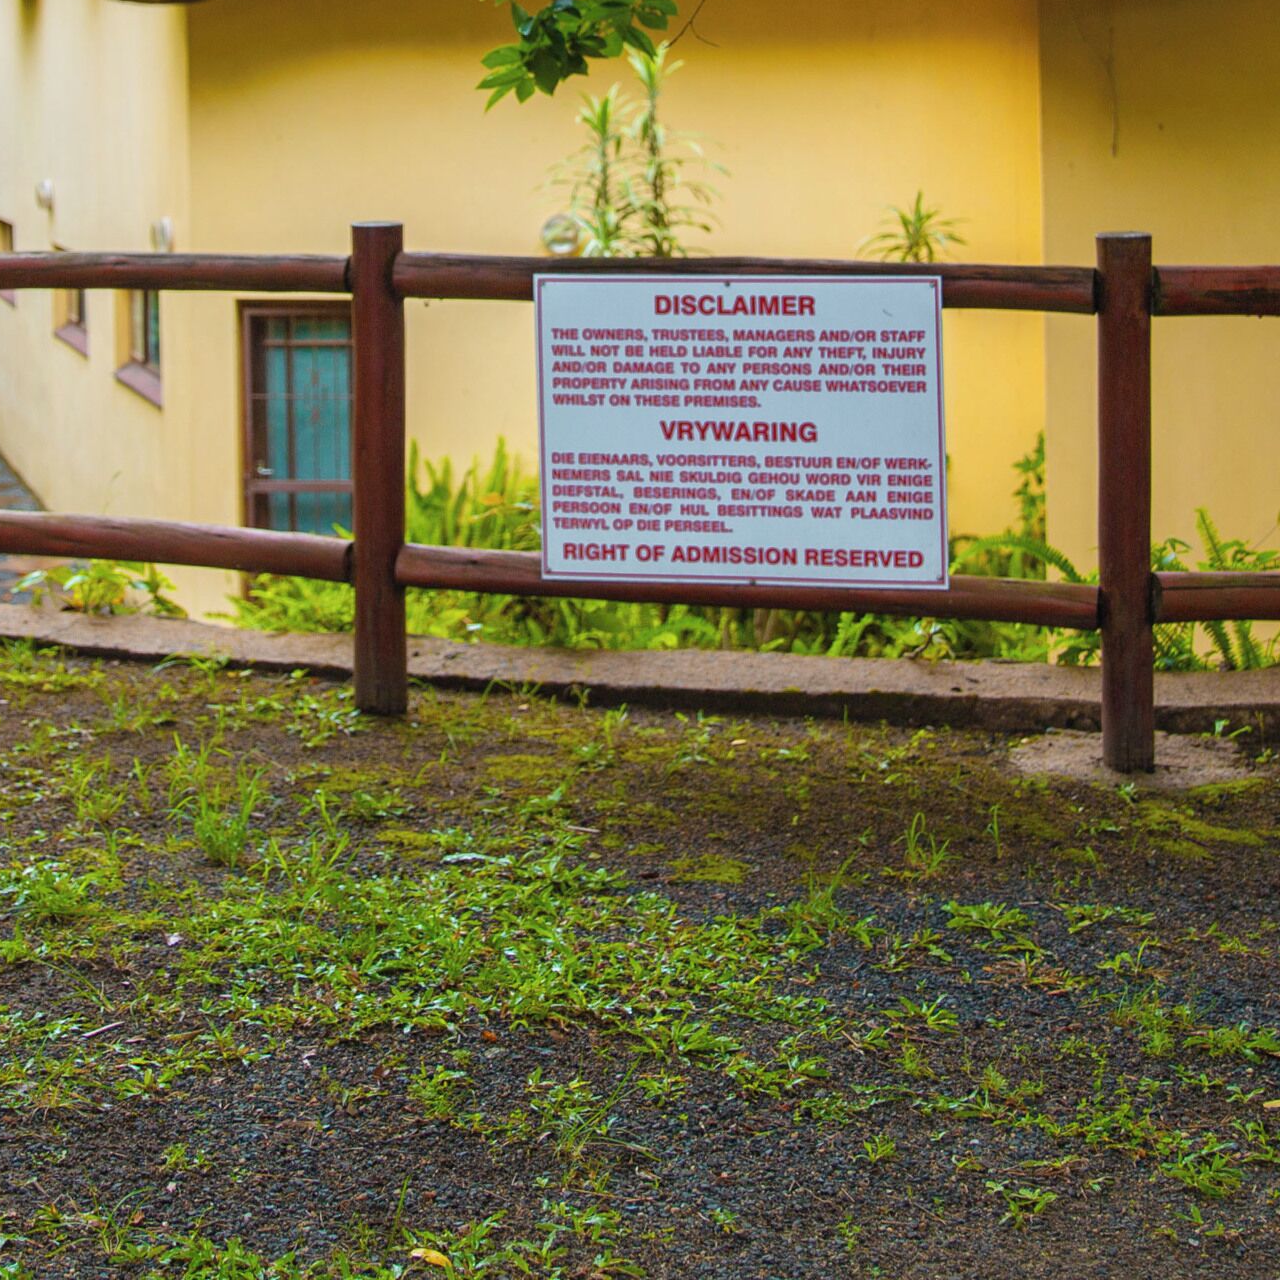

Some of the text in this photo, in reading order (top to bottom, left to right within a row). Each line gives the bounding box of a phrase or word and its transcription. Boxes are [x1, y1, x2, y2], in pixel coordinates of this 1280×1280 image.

[655, 295, 815, 315] DISCLAIMER
[552, 328, 578, 340] THE
[733, 330, 815, 341] MANAGERS
[819, 330, 876, 342] AND/OR
[880, 330, 925, 342] STAFF
[552, 345, 585, 356] WILL
[591, 345, 619, 356] NOT
[625, 345, 643, 357] BE
[649, 345, 687, 357] HELD
[693, 346, 742, 358] LIABLE
[748, 346, 777, 358] FOR
[783, 347, 813, 358] ANY
[872, 347, 926, 359] INJURY
[552, 361, 926, 376] AND/OR DAMAGE TO ANY PERSONS AND/OR THEIR
[553, 377, 926, 392] PROPERTY ARISING FROM ANY CAUSE WHATSOEVER
[553, 394, 605, 406] WHILST
[609, 395, 630, 406] ON
[634, 395, 680, 407] THESE
[660, 421, 817, 441] VRYWARING
[552, 452, 575, 464] DIE
[765, 456, 832, 468] BESTUUR
[837, 457, 880, 469] EN/OF
[552, 469, 932, 487] NEMERS SAL NIE SKULDIG GEHOU WORD VIR ENIGE
[731, 489, 775, 500] EN/OF
[786, 490, 835, 502] SKADE
[846, 491, 877, 502] AAN
[888, 491, 933, 503] ENIGE
[553, 501, 933, 520] PERSOON EN/OF HUL BESITTINGS WAT PLAASVIND
[554, 518, 609, 529] TERWYL
[614, 519, 633, 530] OP
[637, 519, 660, 531] DIE
[563, 543, 924, 567] RIGHT OF ADMISSION RESERVED
